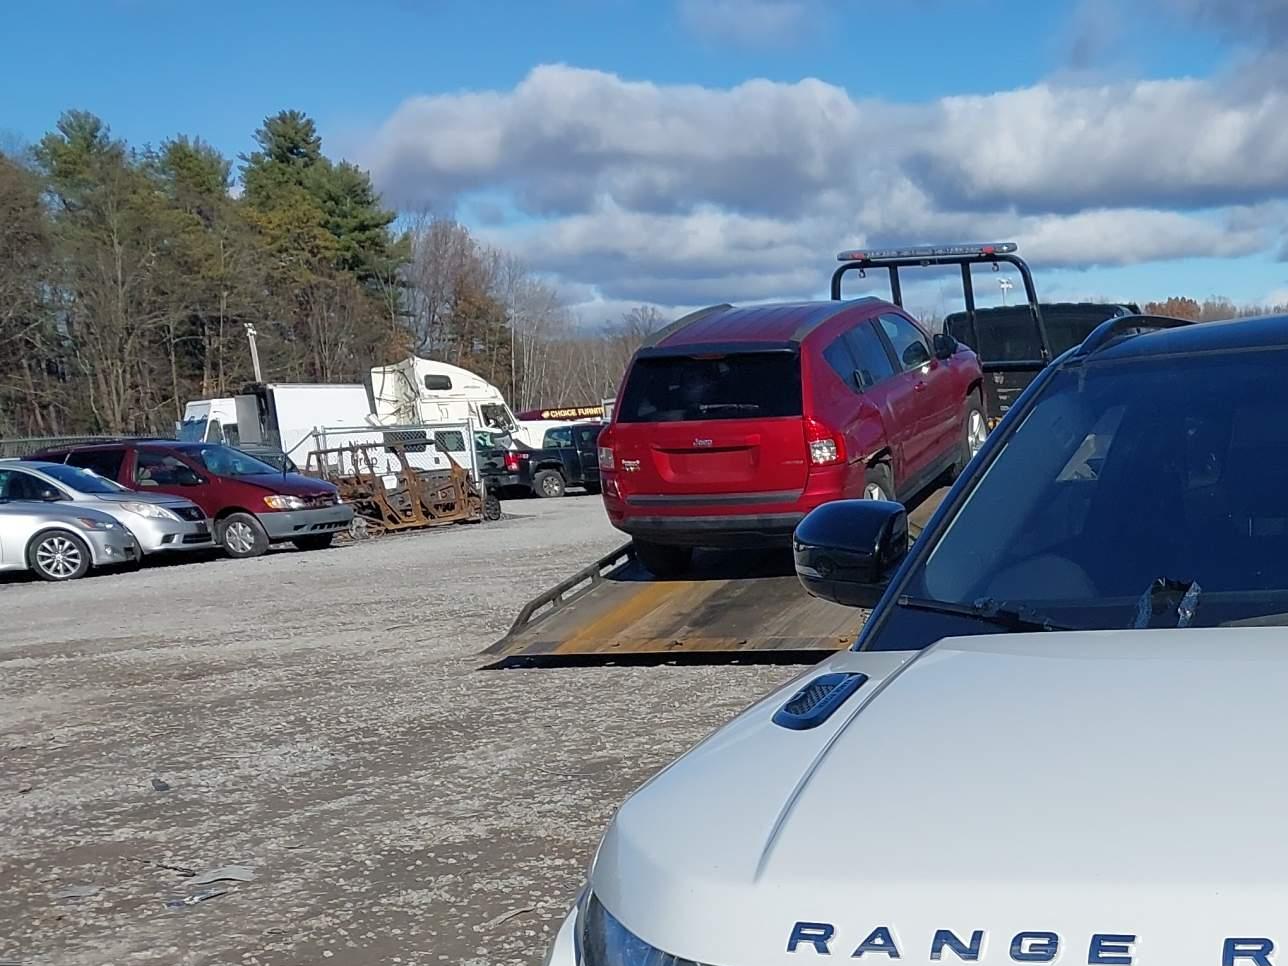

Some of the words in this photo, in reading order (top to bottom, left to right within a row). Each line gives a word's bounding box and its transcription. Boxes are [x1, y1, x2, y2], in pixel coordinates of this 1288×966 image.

[550, 408, 577, 418] CHOICE
[348, 439, 378, 456] Niht
[786, 921, 1137, 966] RANGE
